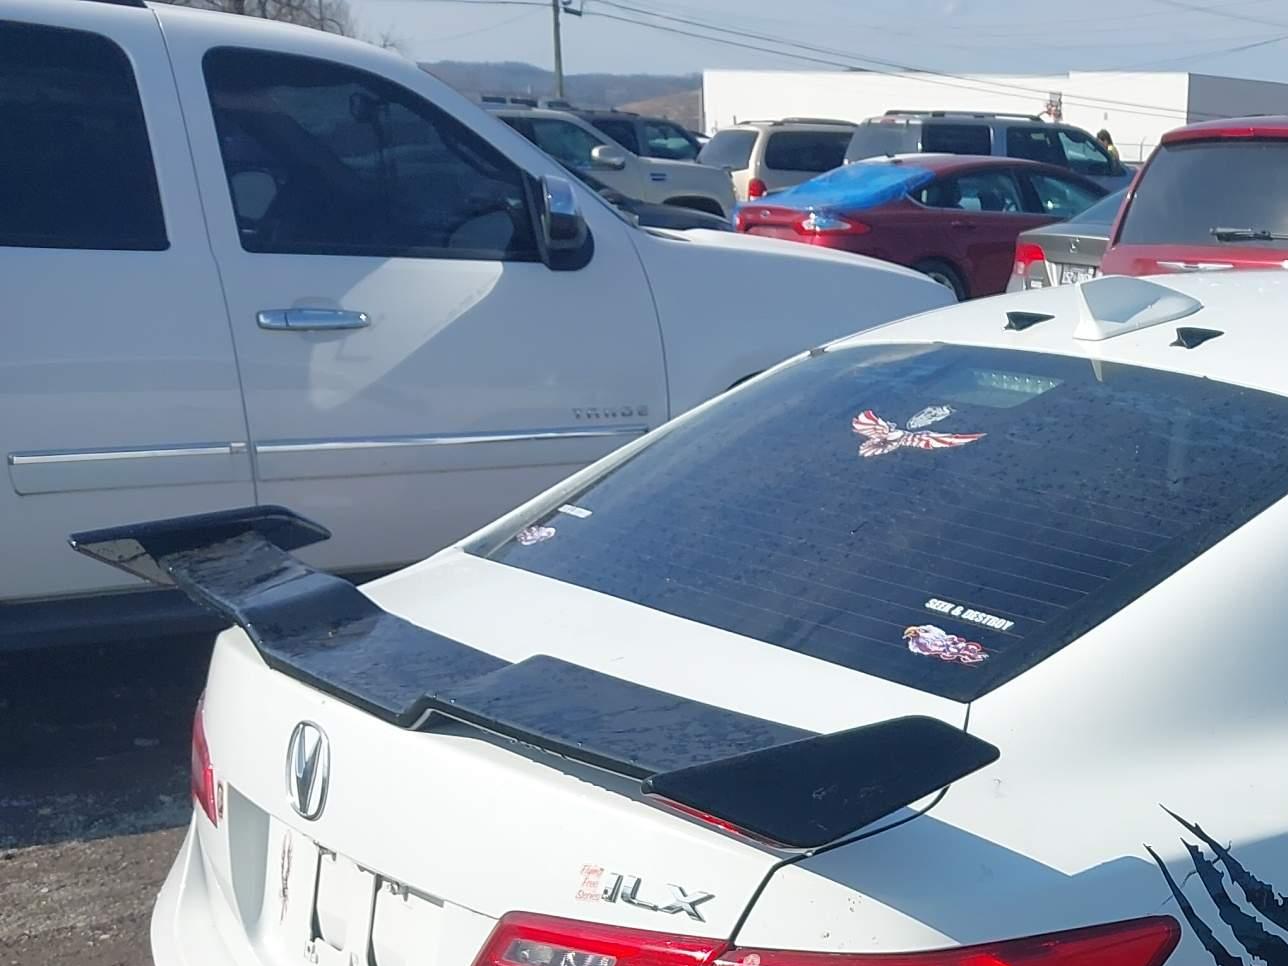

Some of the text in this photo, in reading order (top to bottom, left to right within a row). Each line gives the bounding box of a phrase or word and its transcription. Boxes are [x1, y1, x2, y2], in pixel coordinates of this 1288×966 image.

[924, 598, 1015, 631] SEEK & DESTROY
[602, 872, 717, 924] ILX
